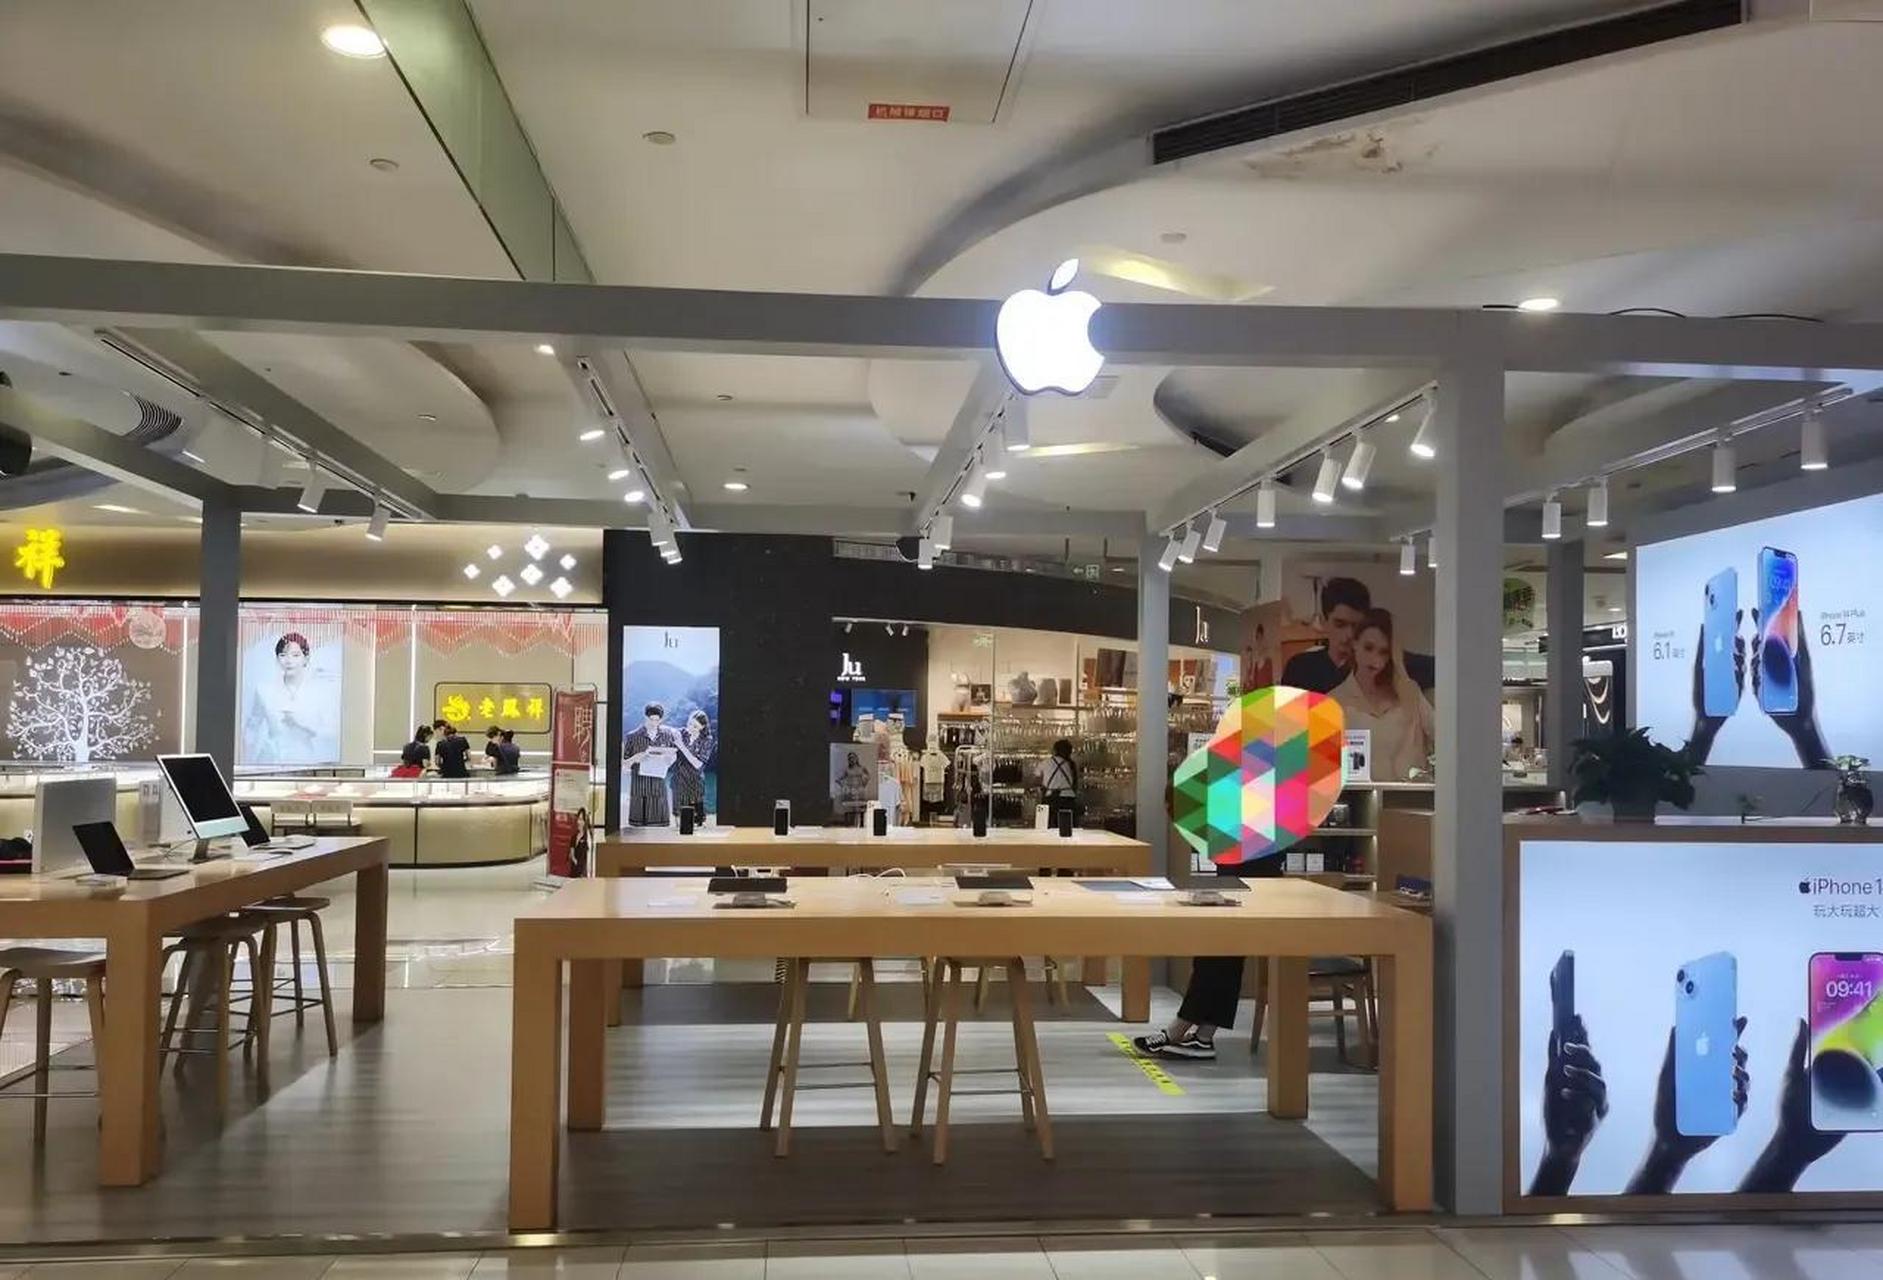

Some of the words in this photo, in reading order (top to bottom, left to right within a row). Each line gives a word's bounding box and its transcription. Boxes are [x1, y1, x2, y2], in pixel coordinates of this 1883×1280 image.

[15, 529, 65, 589] 祥
[1813, 878, 1873, 895] iPhone
[1826, 980, 1872, 998] 09:41
